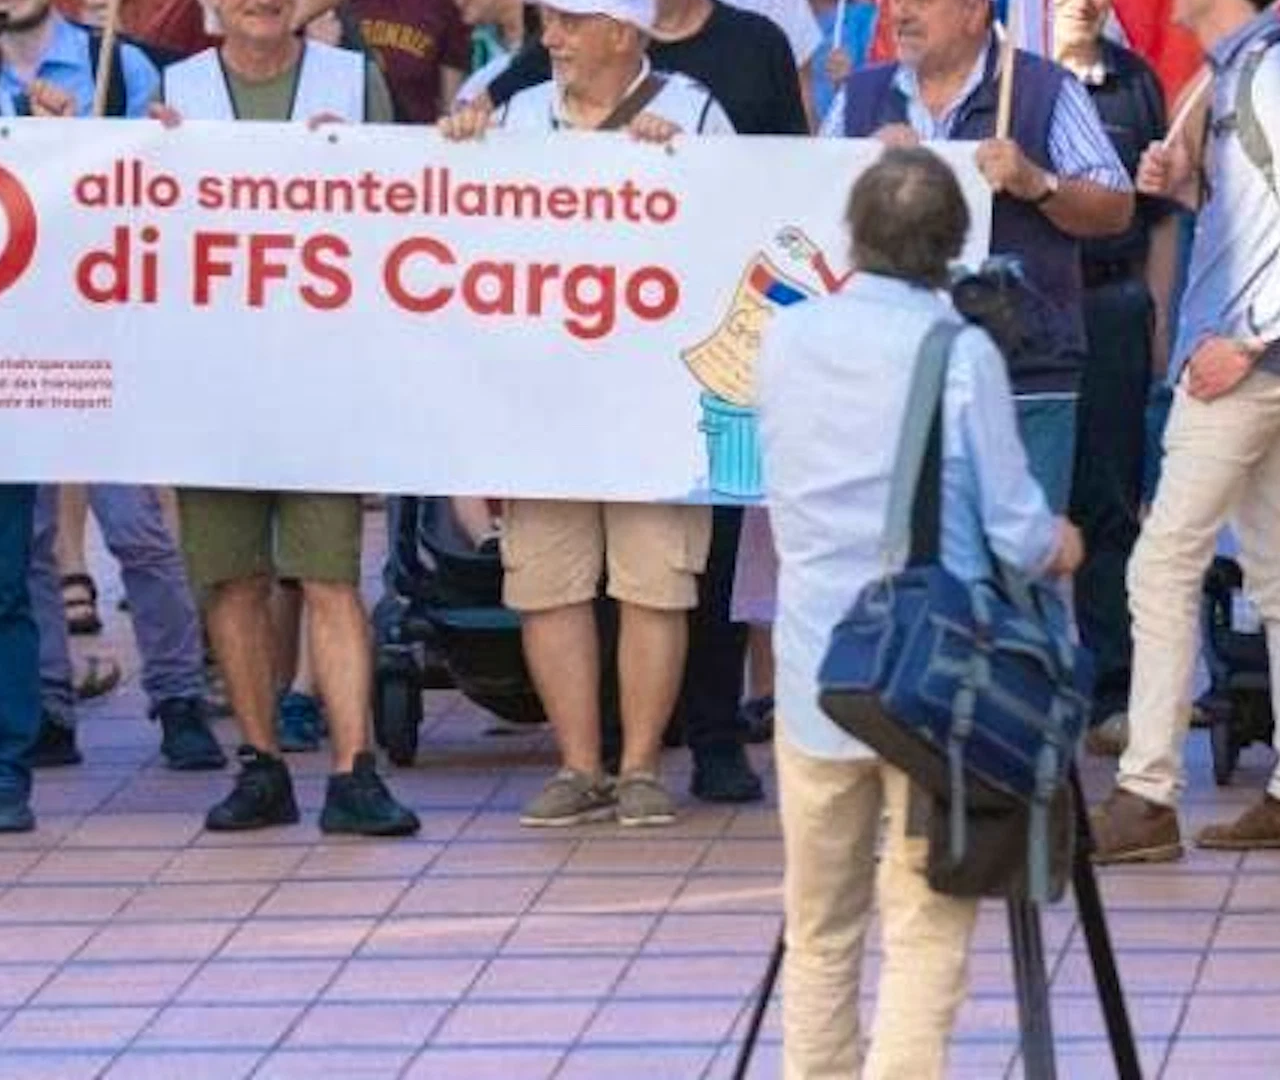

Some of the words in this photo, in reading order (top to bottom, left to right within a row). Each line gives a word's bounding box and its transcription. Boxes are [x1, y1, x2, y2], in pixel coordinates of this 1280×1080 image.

[75, 160, 180, 208] allo
[197, 166, 679, 224] smantellamento
[75, 226, 159, 304] di
[193, 231, 353, 311] FFS
[383, 235, 680, 341] Cargo
